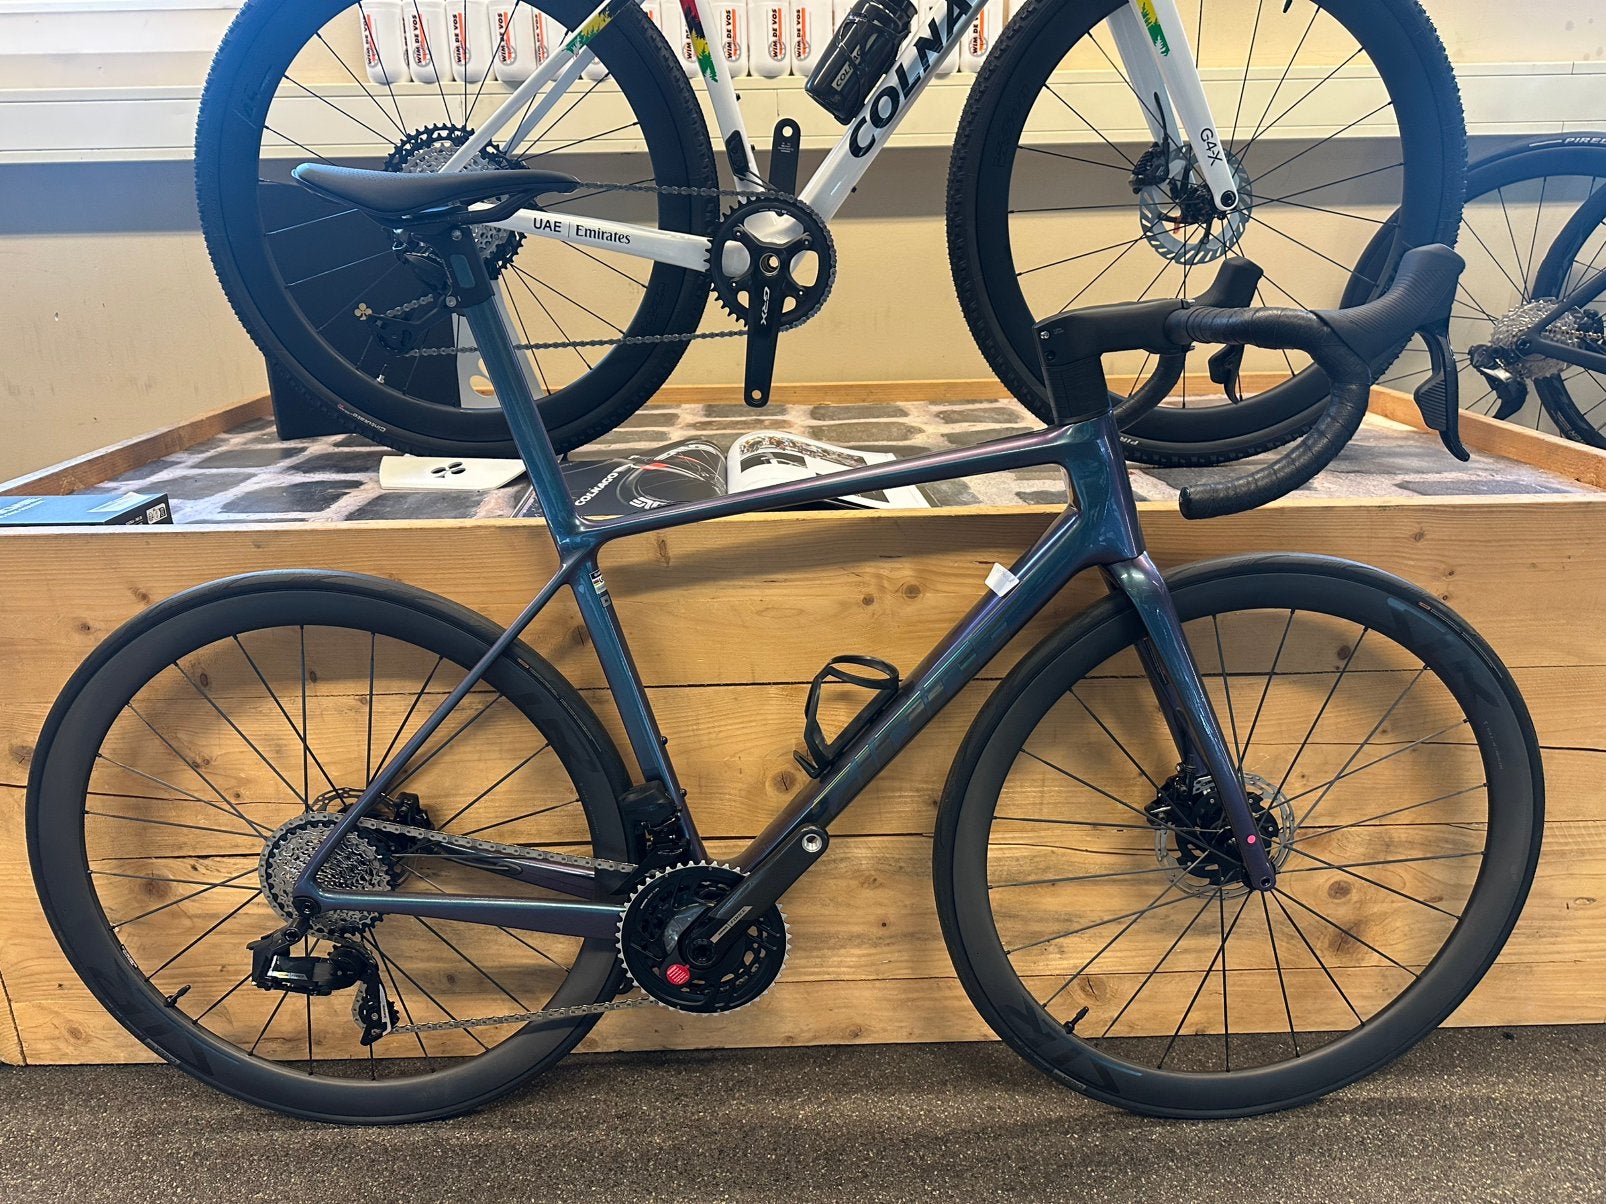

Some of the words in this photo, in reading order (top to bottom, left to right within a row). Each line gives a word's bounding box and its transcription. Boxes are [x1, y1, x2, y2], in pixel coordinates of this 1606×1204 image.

[726, 29, 732, 39] DE
[772, 28, 778, 37] DE
[796, 28, 801, 37] DE
[973, 24, 979, 34] DE
[414, 33, 420, 44] DE
[454, 32, 460, 43] DE
[1200, 127, 1223, 167] G4-X
[533, 217, 562, 233] UAE
[575, 224, 631, 245] Emirates
[760, 286, 771, 326] GRX
[574, 471, 619, 506] COLNAGO
